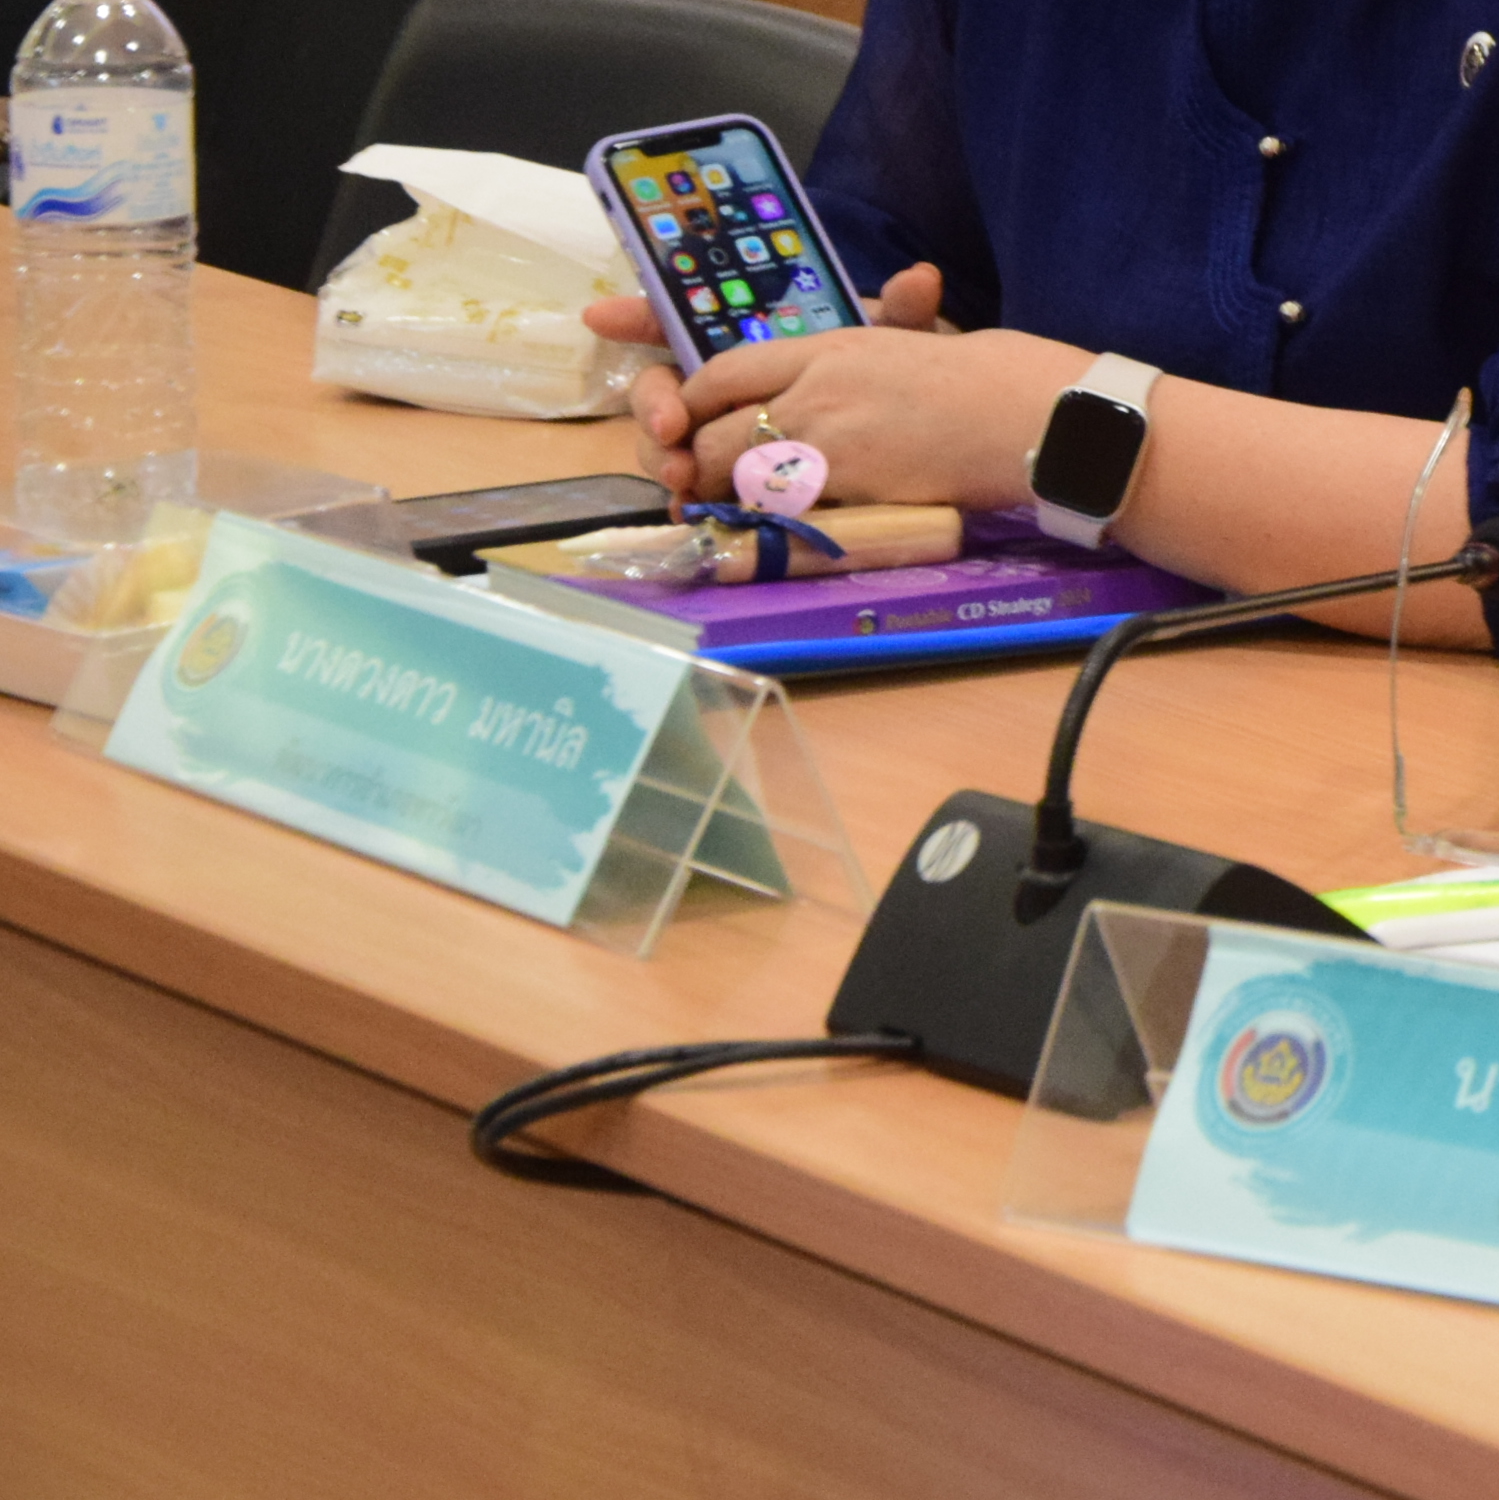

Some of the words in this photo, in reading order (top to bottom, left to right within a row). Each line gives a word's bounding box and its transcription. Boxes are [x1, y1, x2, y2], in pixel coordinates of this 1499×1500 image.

[957, 602, 986, 621] CD
[988, 596, 1053, 616] Strategy
[277, 631, 458, 726] นางดวงดาว
